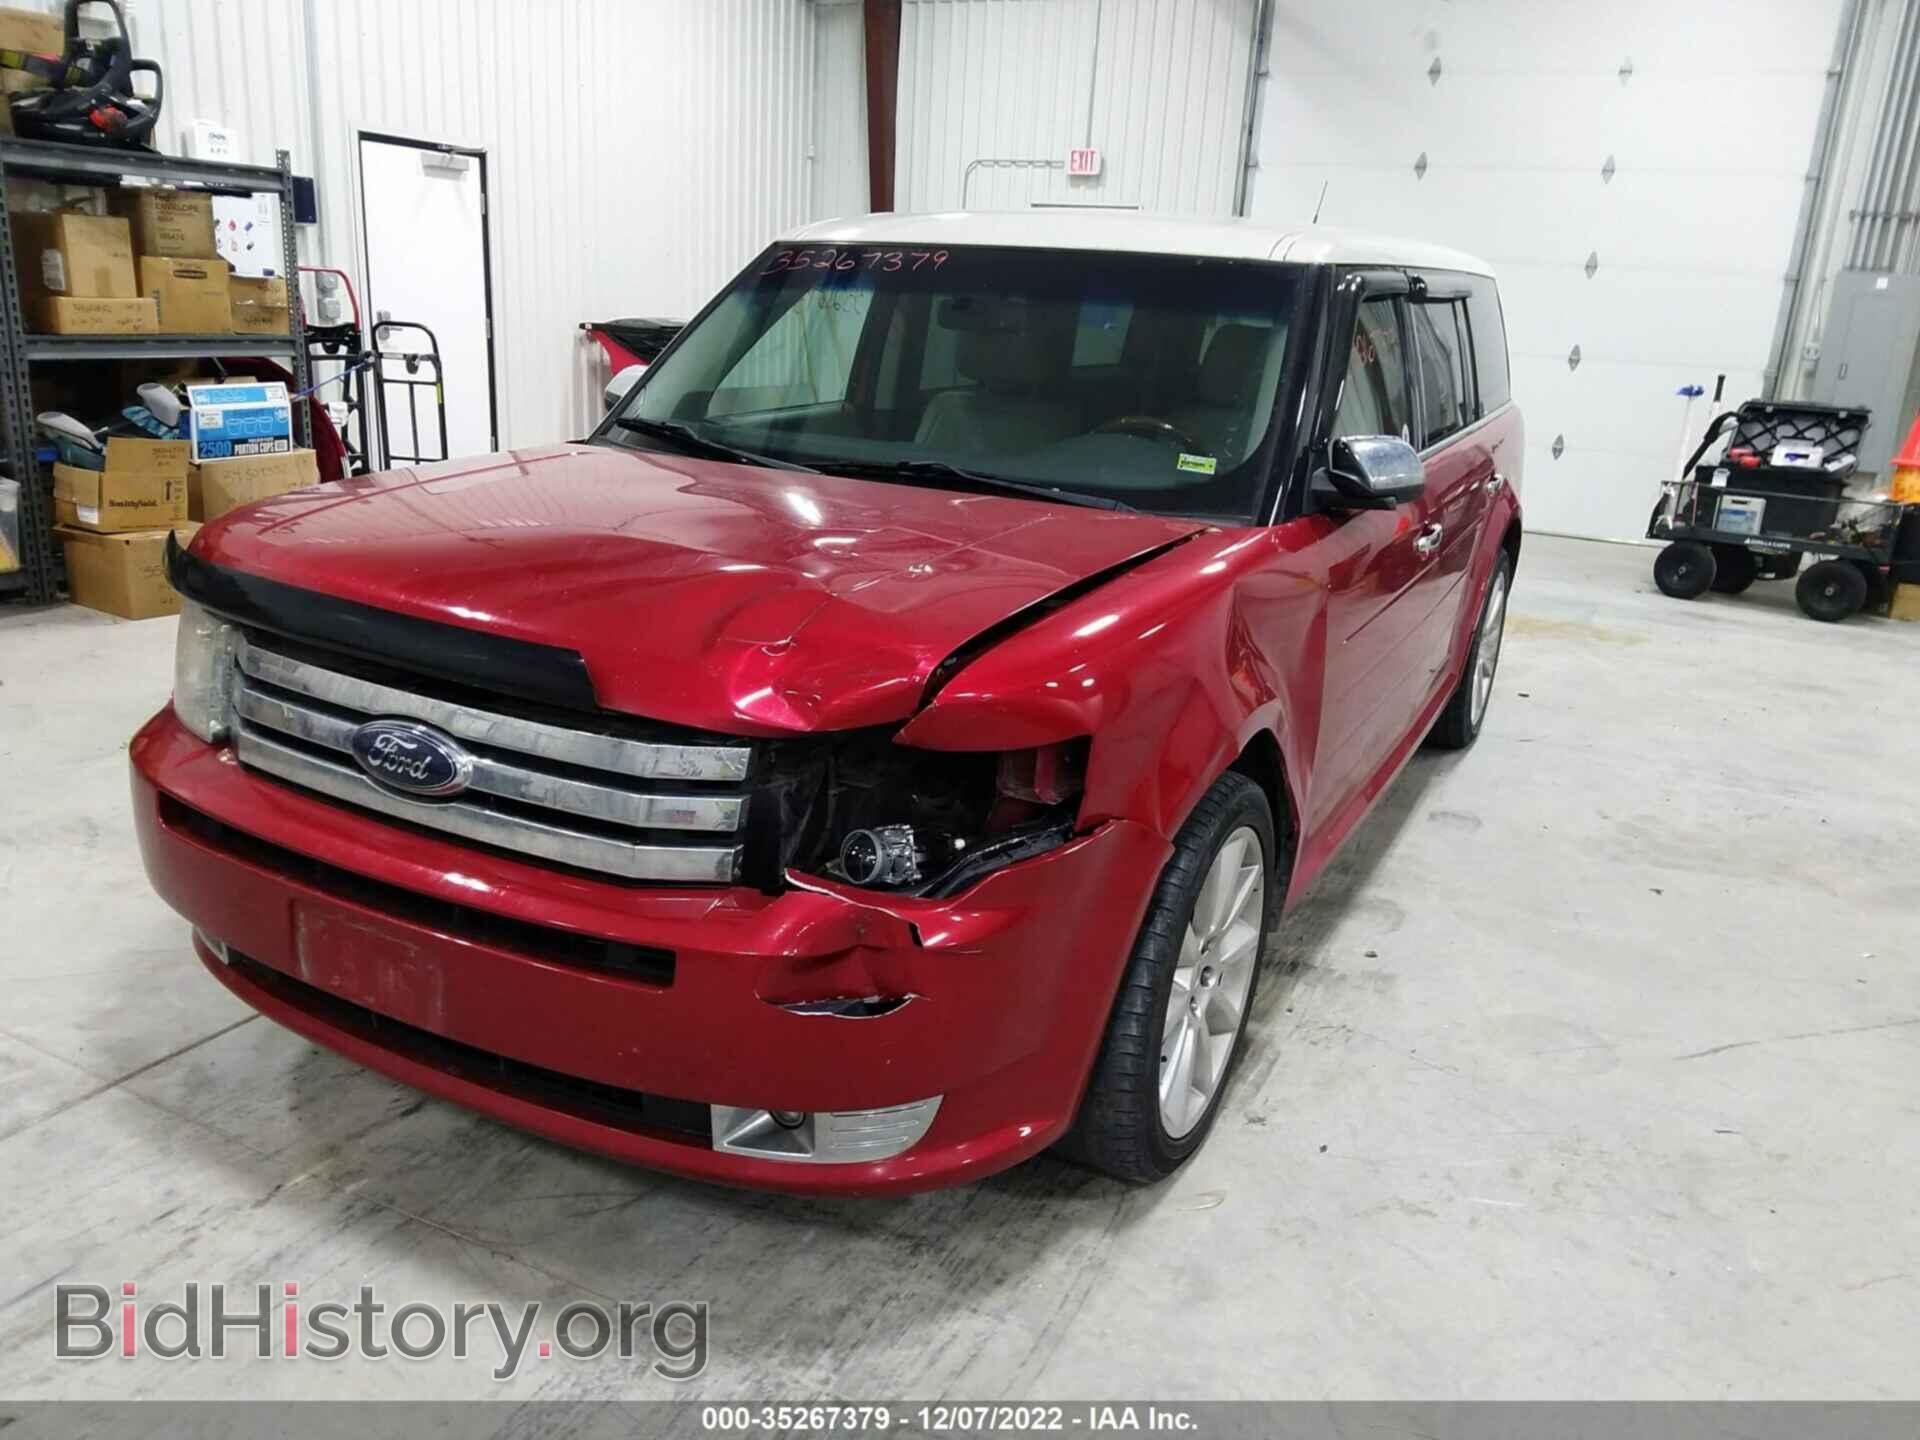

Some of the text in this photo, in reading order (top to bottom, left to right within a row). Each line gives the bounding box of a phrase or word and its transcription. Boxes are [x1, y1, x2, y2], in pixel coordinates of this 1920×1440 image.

[1070, 150, 1097, 171] EXIT
[200, 440, 233, 458] 2500
[368, 734, 432, 780] Ford
